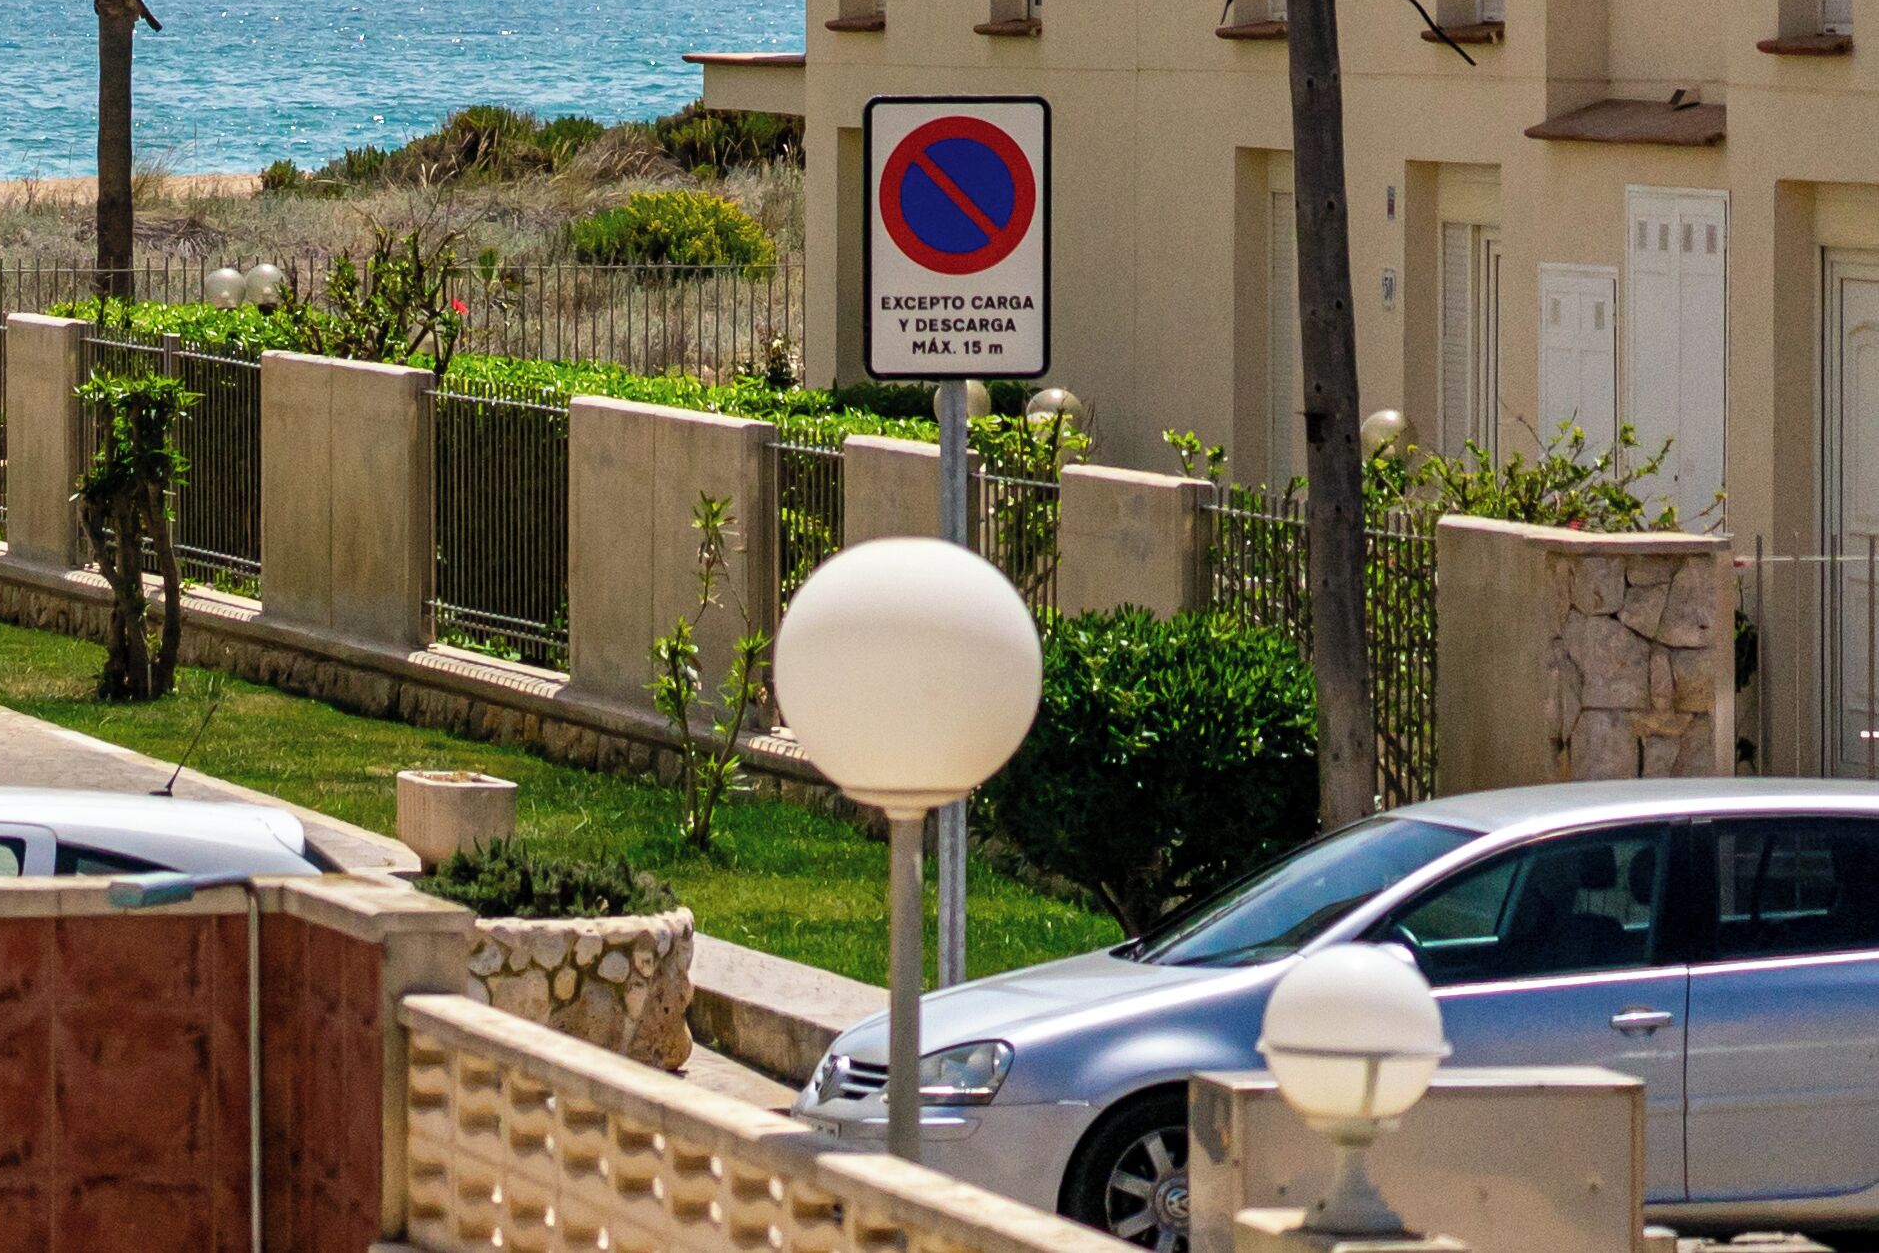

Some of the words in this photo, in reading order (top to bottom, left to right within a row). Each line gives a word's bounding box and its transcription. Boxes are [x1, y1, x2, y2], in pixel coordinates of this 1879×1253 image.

[881, 295, 964, 310] EXCEPTO
[971, 295, 1034, 310] CARGA
[898, 317, 910, 332] Y
[915, 317, 1016, 332] DESCARGA
[912, 337, 956, 354] MÁX.
[963, 340, 982, 354] 15
[988, 343, 1003, 354] m
